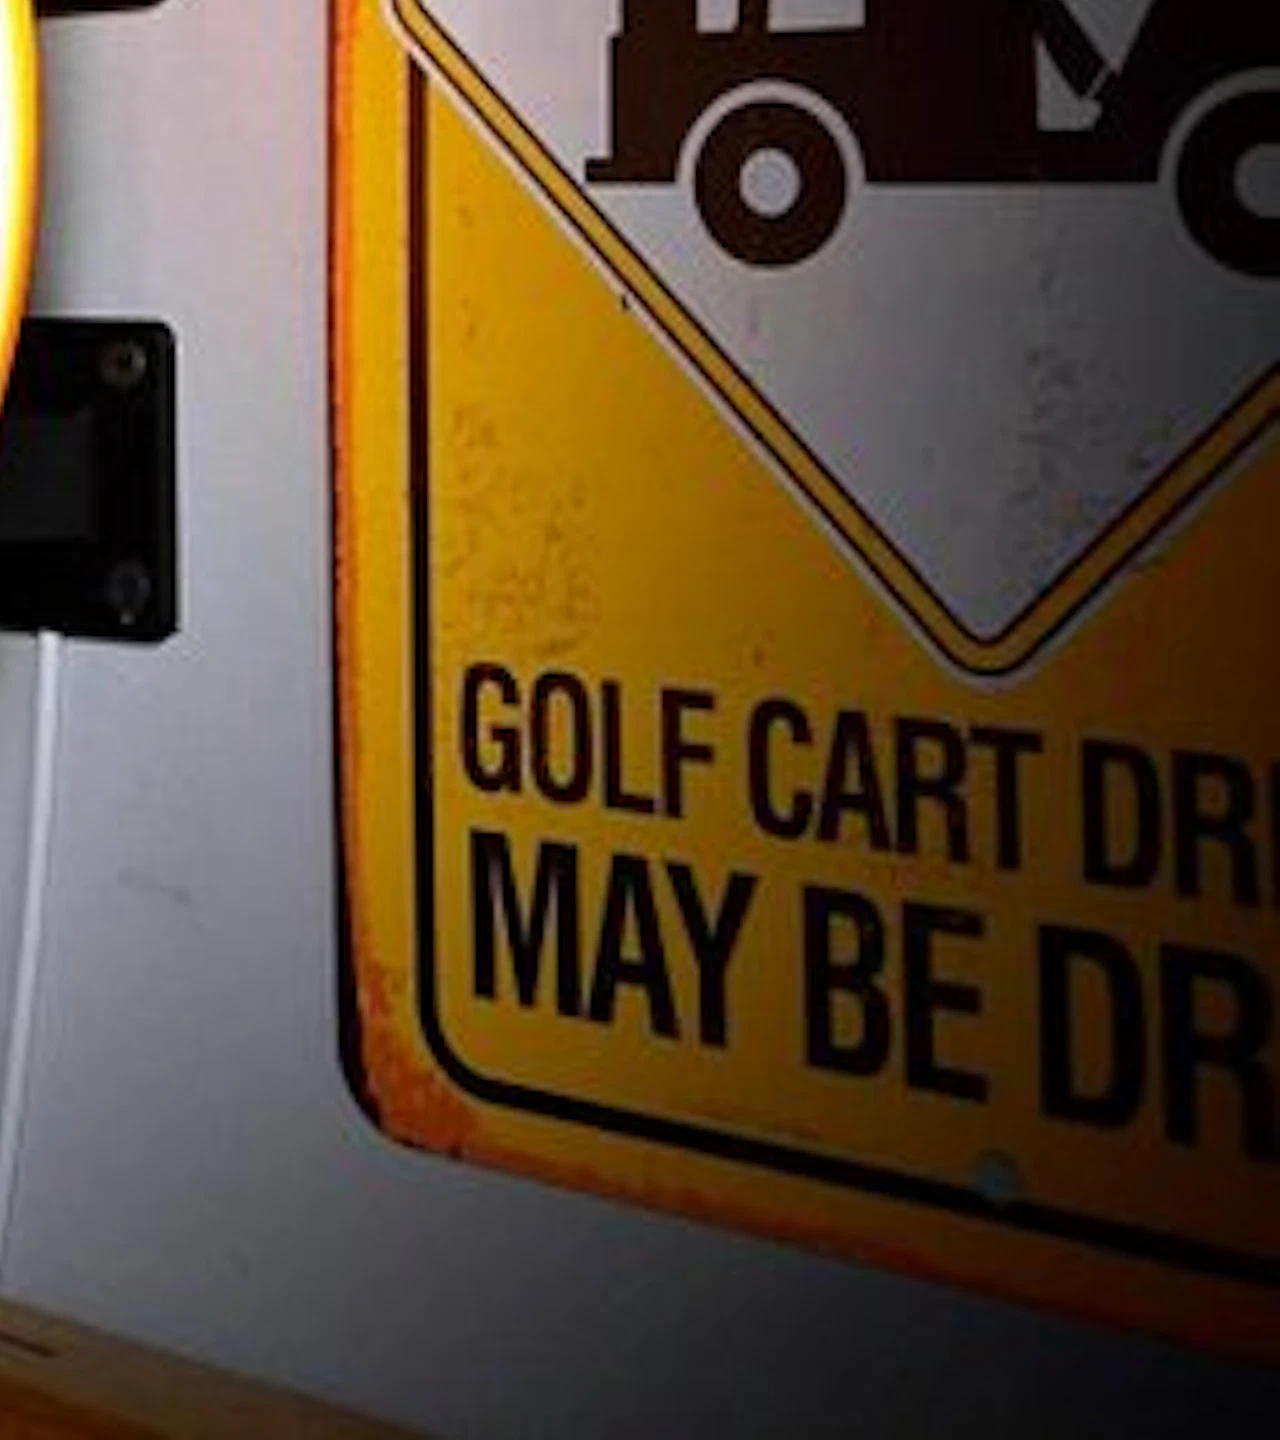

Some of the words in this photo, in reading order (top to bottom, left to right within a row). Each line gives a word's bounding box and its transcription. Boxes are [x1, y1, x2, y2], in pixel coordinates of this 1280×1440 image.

[460, 662, 715, 819] GOLF
[749, 697, 1042, 872] CART
[1082, 738, 1280, 908] DR
[469, 828, 758, 1048] MAY
[802, 884, 989, 1105] BE
